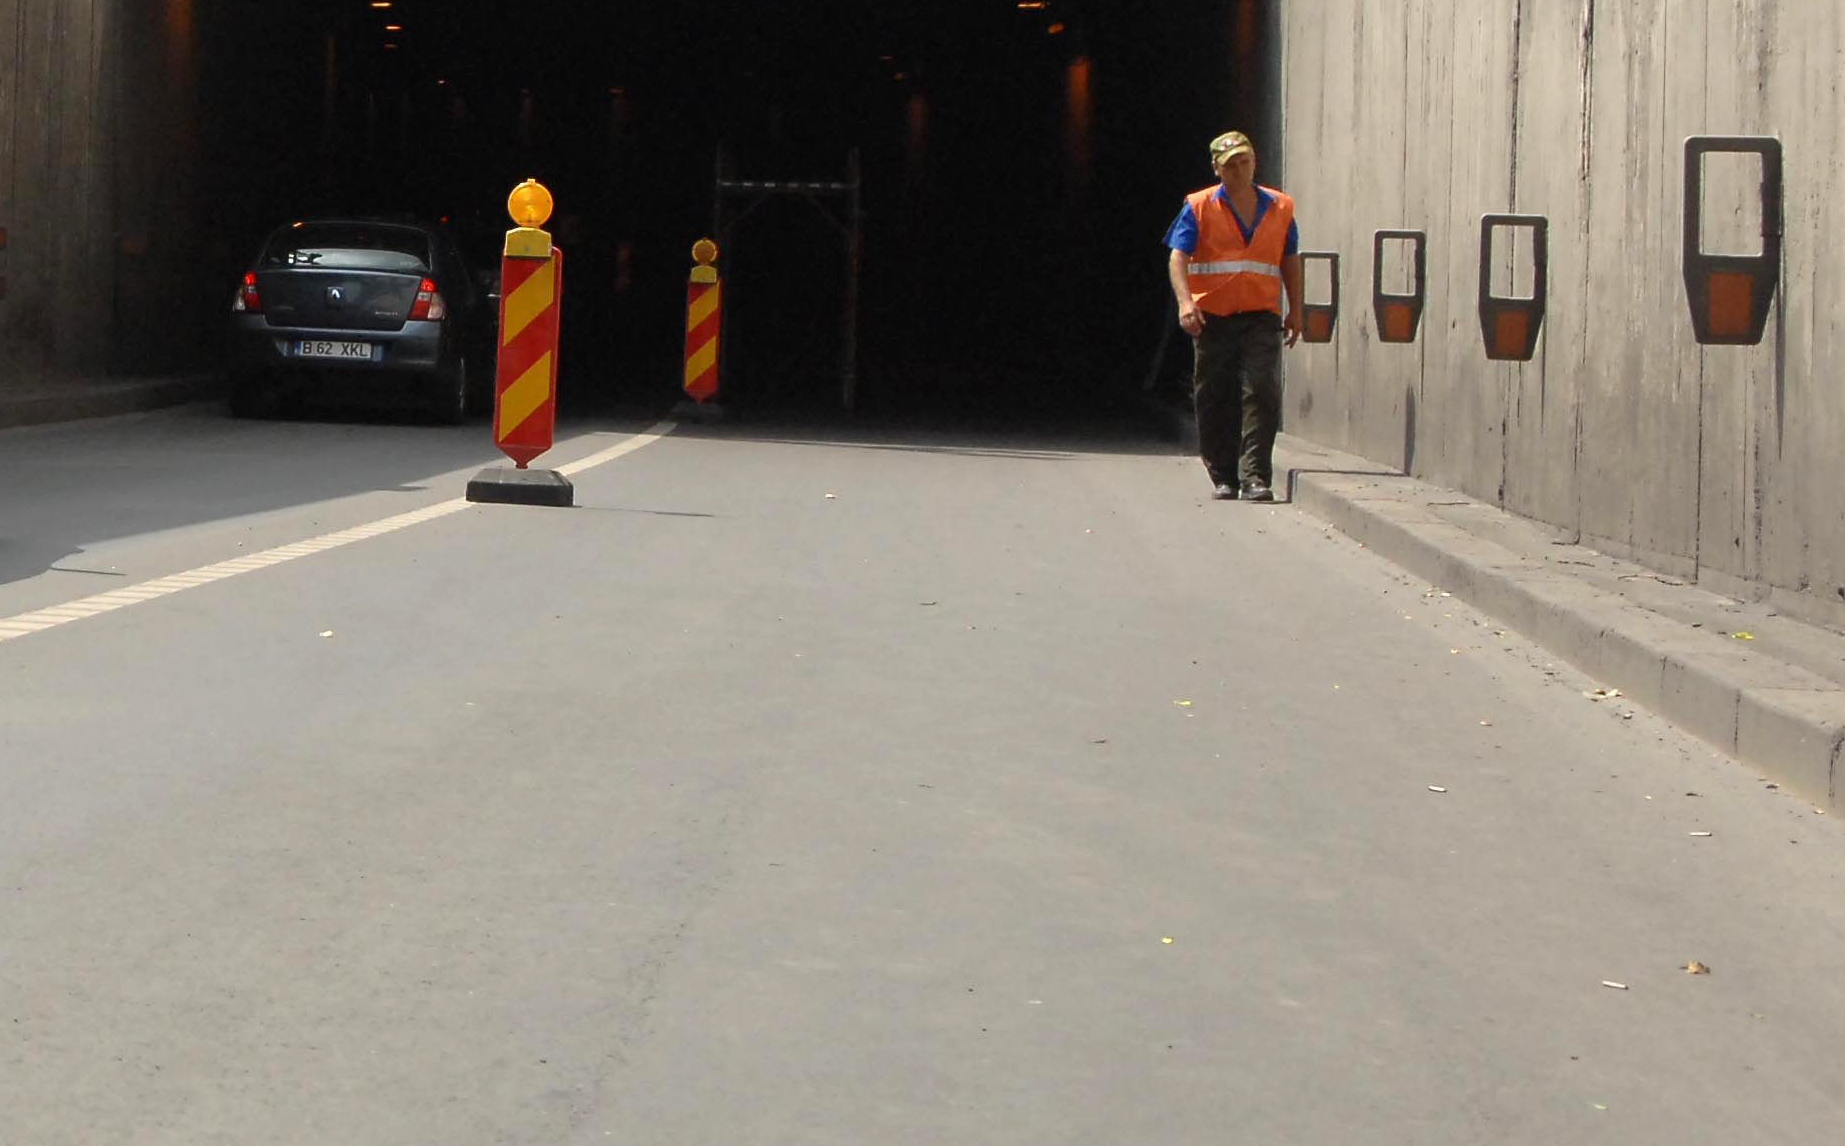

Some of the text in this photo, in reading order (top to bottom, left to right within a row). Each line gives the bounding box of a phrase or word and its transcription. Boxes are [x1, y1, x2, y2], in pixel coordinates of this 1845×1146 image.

[302, 341, 369, 358] B 62 XKL
